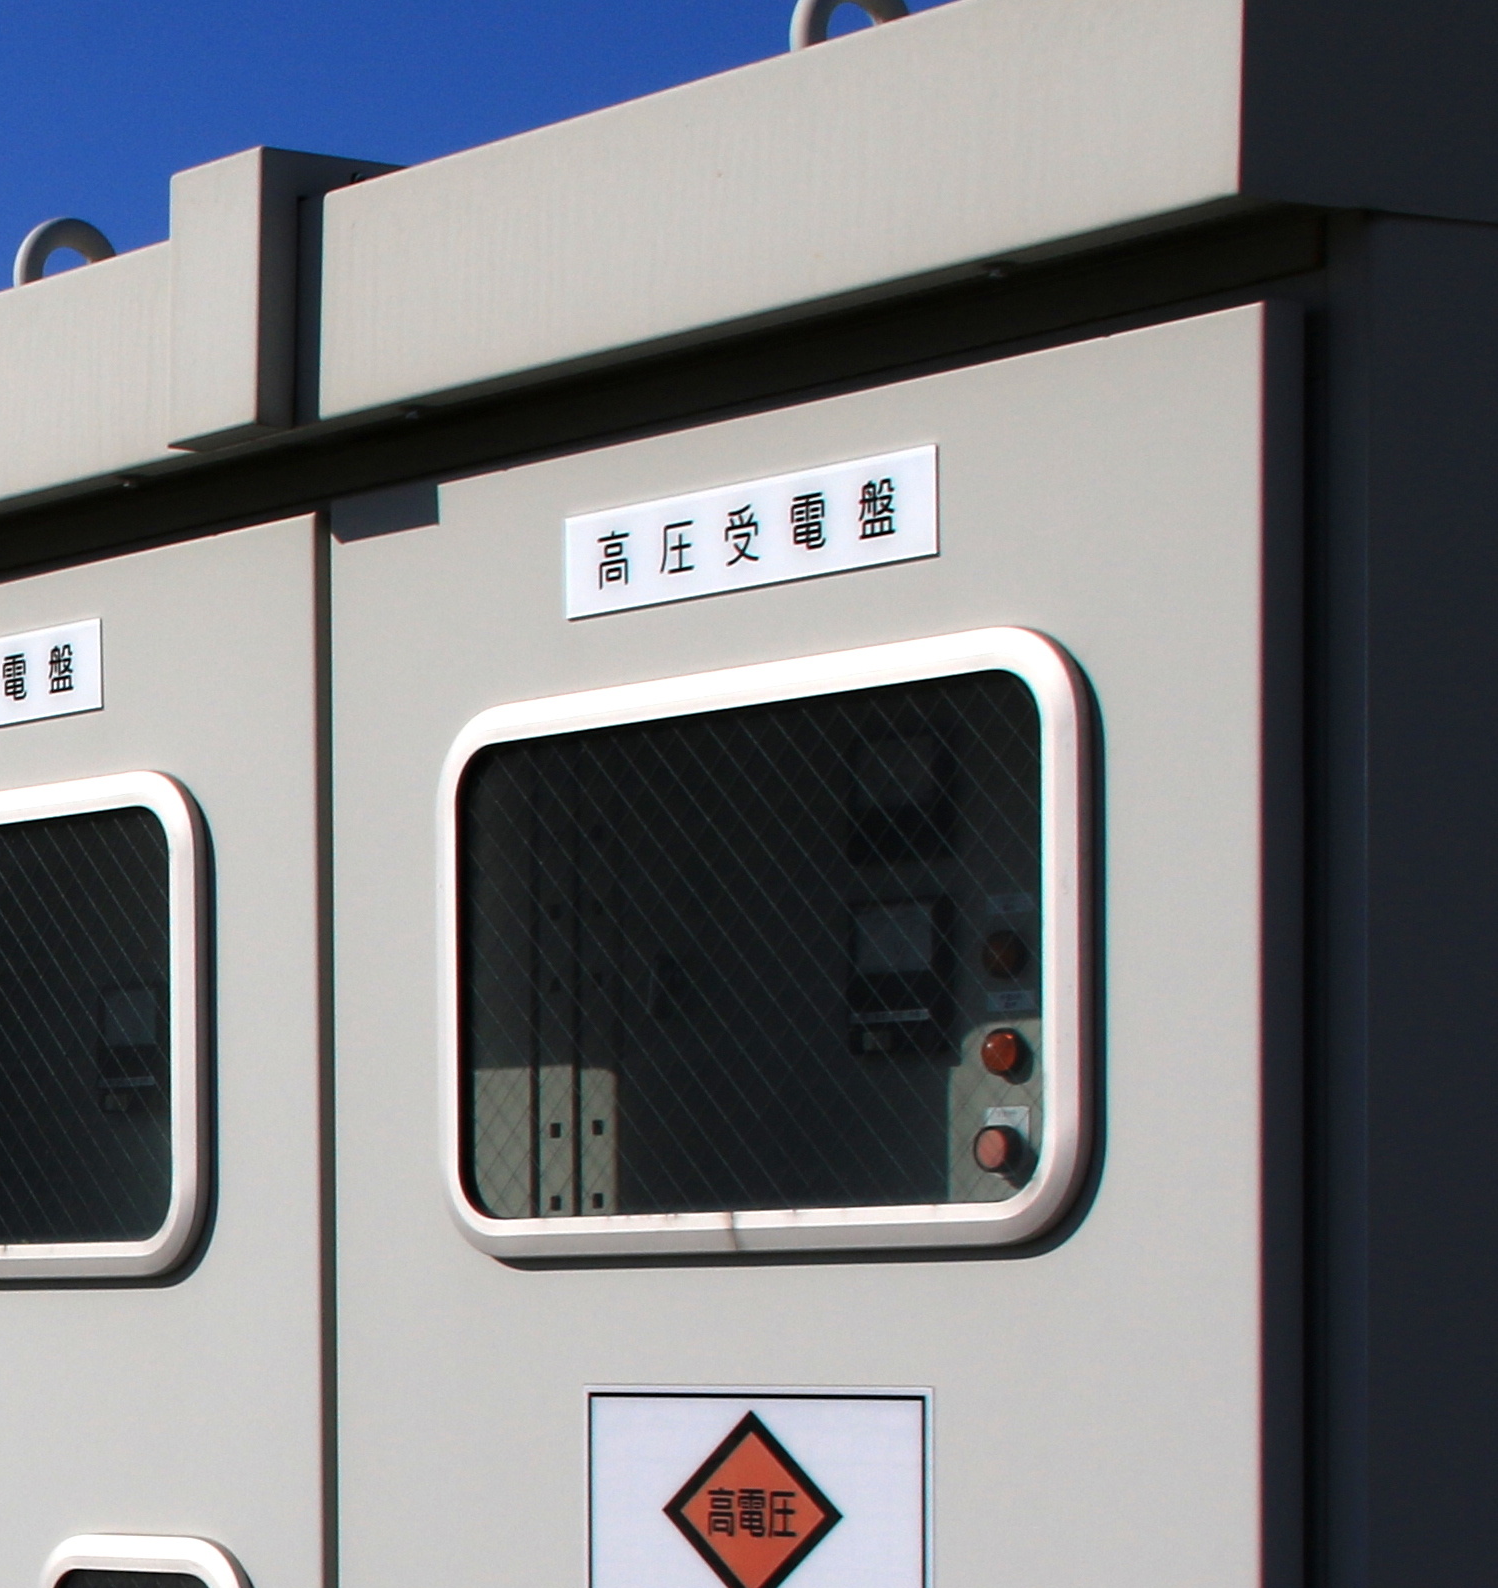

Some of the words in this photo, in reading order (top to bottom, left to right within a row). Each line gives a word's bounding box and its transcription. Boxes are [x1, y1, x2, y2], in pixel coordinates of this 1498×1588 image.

[596, 477, 897, 591] 高圧受電盤
[706, 1486, 798, 1539] 高電圧
